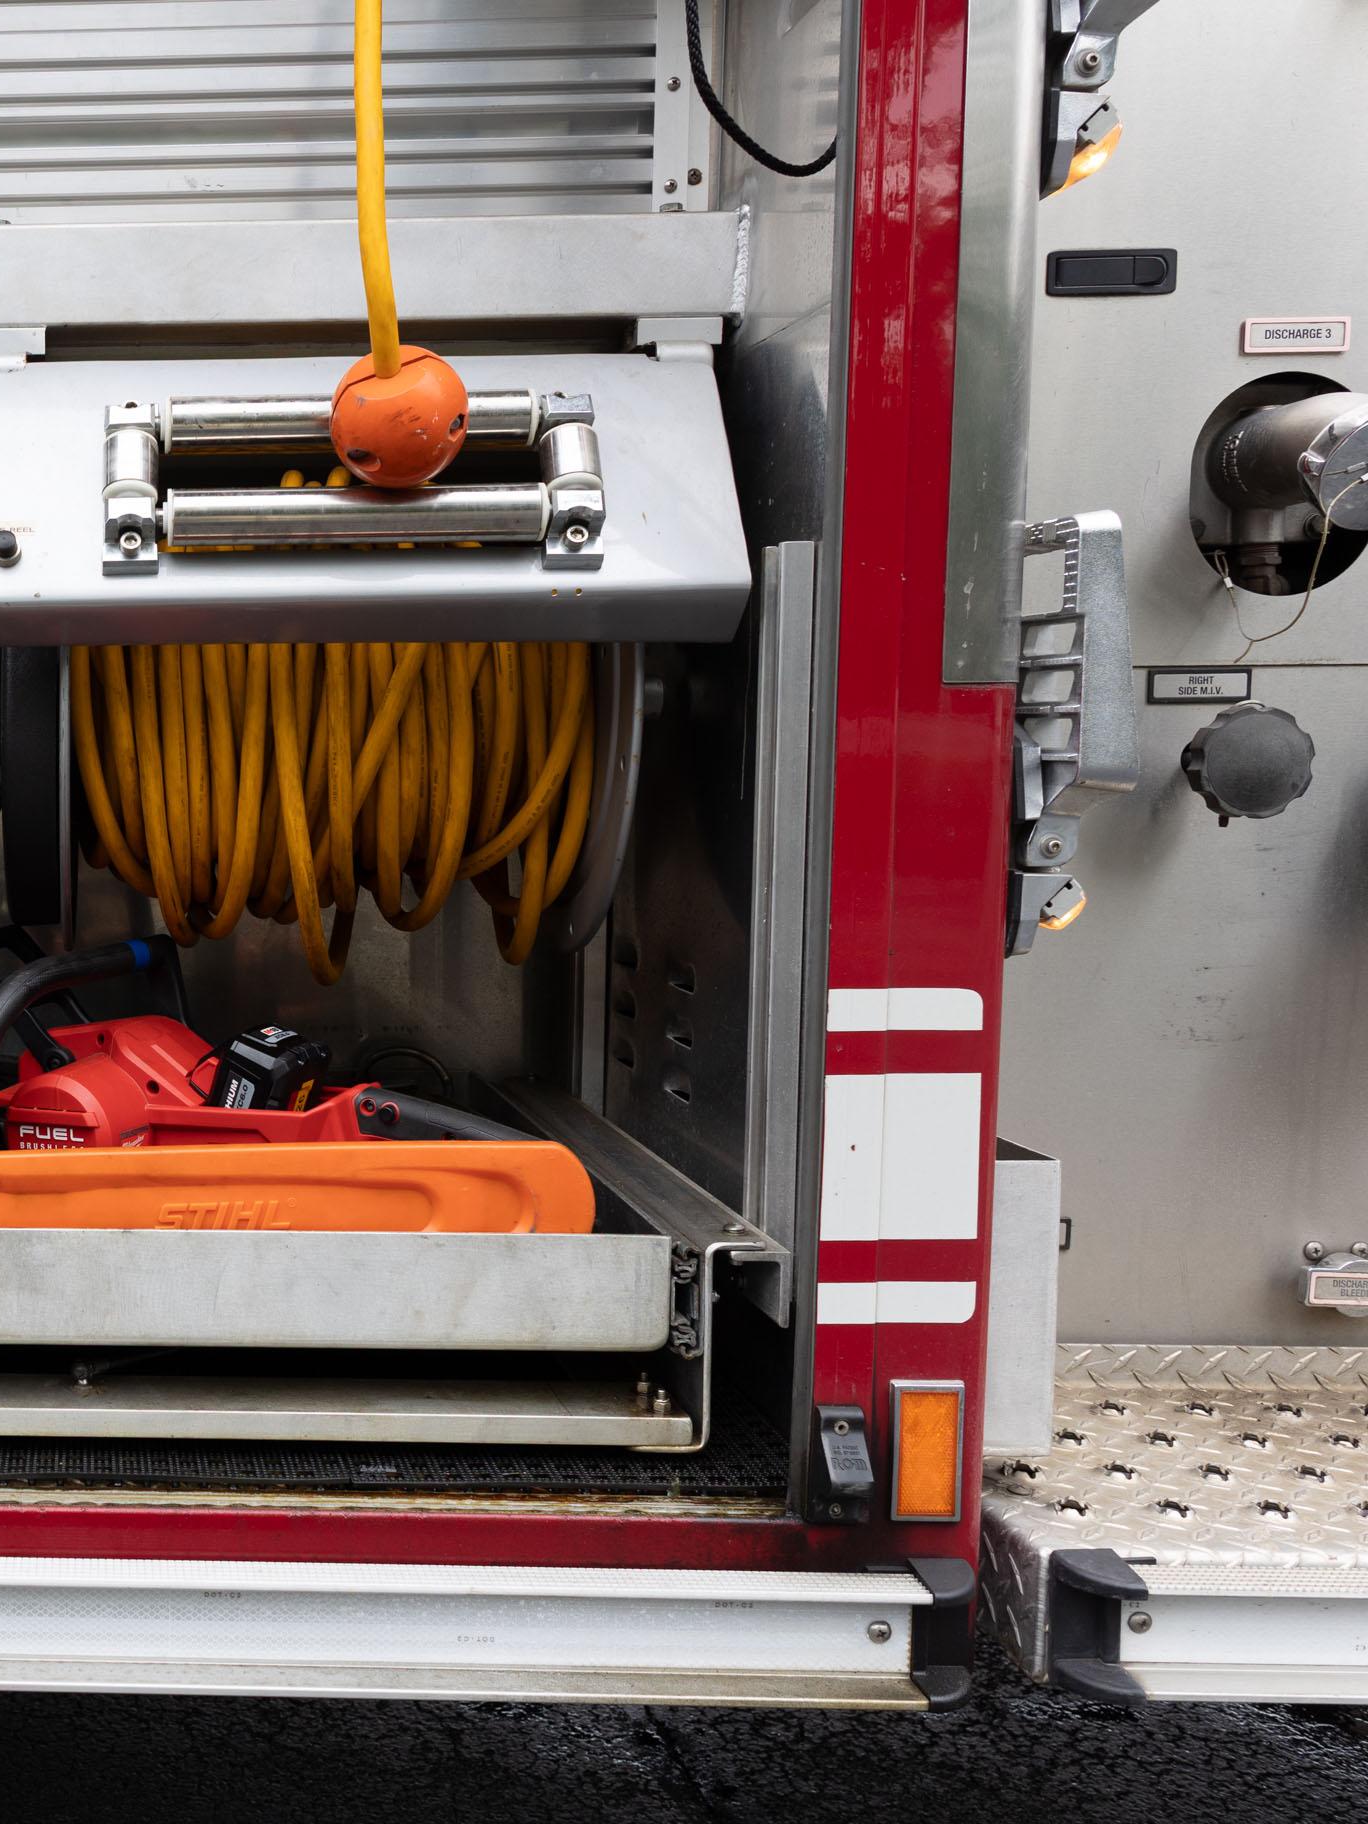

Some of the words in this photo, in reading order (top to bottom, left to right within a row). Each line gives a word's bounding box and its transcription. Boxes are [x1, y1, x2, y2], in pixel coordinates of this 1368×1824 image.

[1264, 329, 1322, 339] DISCHARGE
[1325, 328, 1332, 339] 3
[1188, 676, 1214, 684] RIGHT
[1178, 687, 1198, 695] SIDE
[1199, 686, 1223, 695] M.I.V.
[19, 1125, 85, 1142] FUEL
[154, 1200, 292, 1231] STIHL
[1340, 1288, 1368, 1297] BLEED
